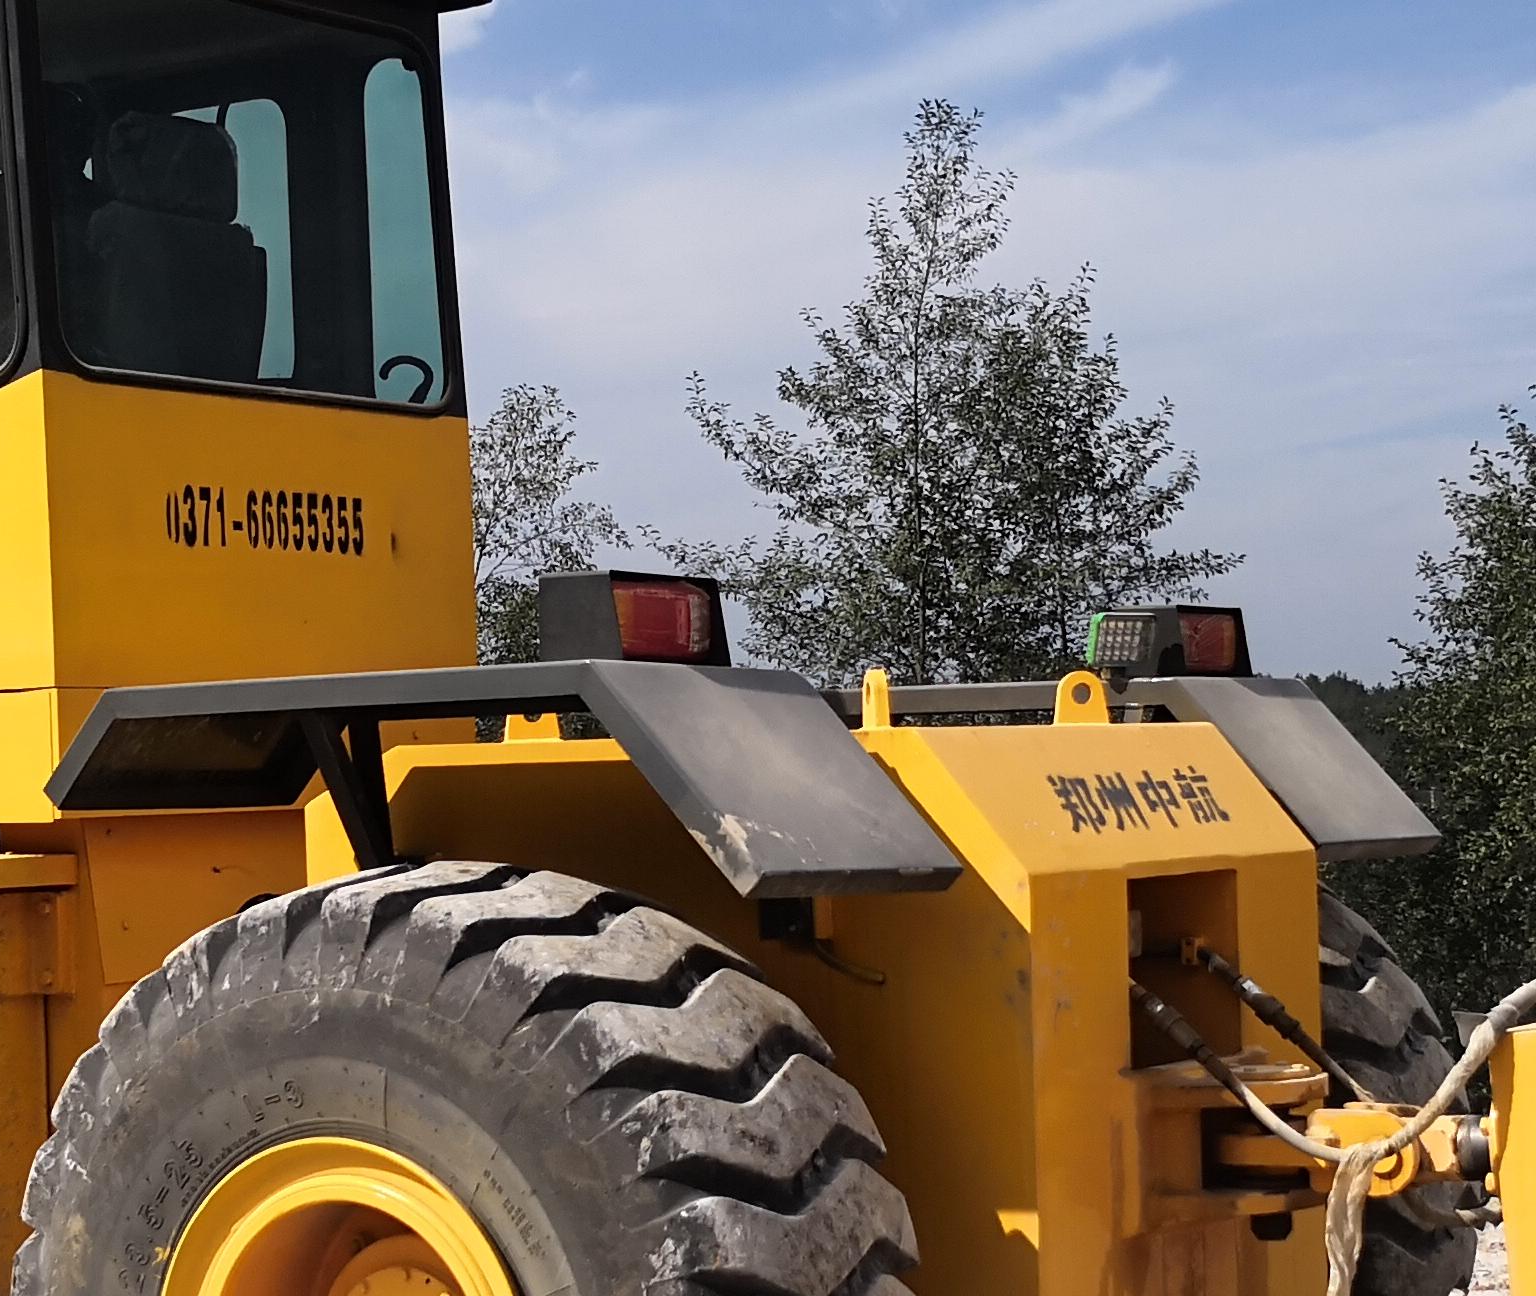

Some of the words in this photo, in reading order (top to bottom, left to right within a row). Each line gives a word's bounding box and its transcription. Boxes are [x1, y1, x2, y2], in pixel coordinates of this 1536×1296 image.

[166, 483, 364, 557] 0371-66655355
[1047, 765, 1231, 834] 郑州中航
